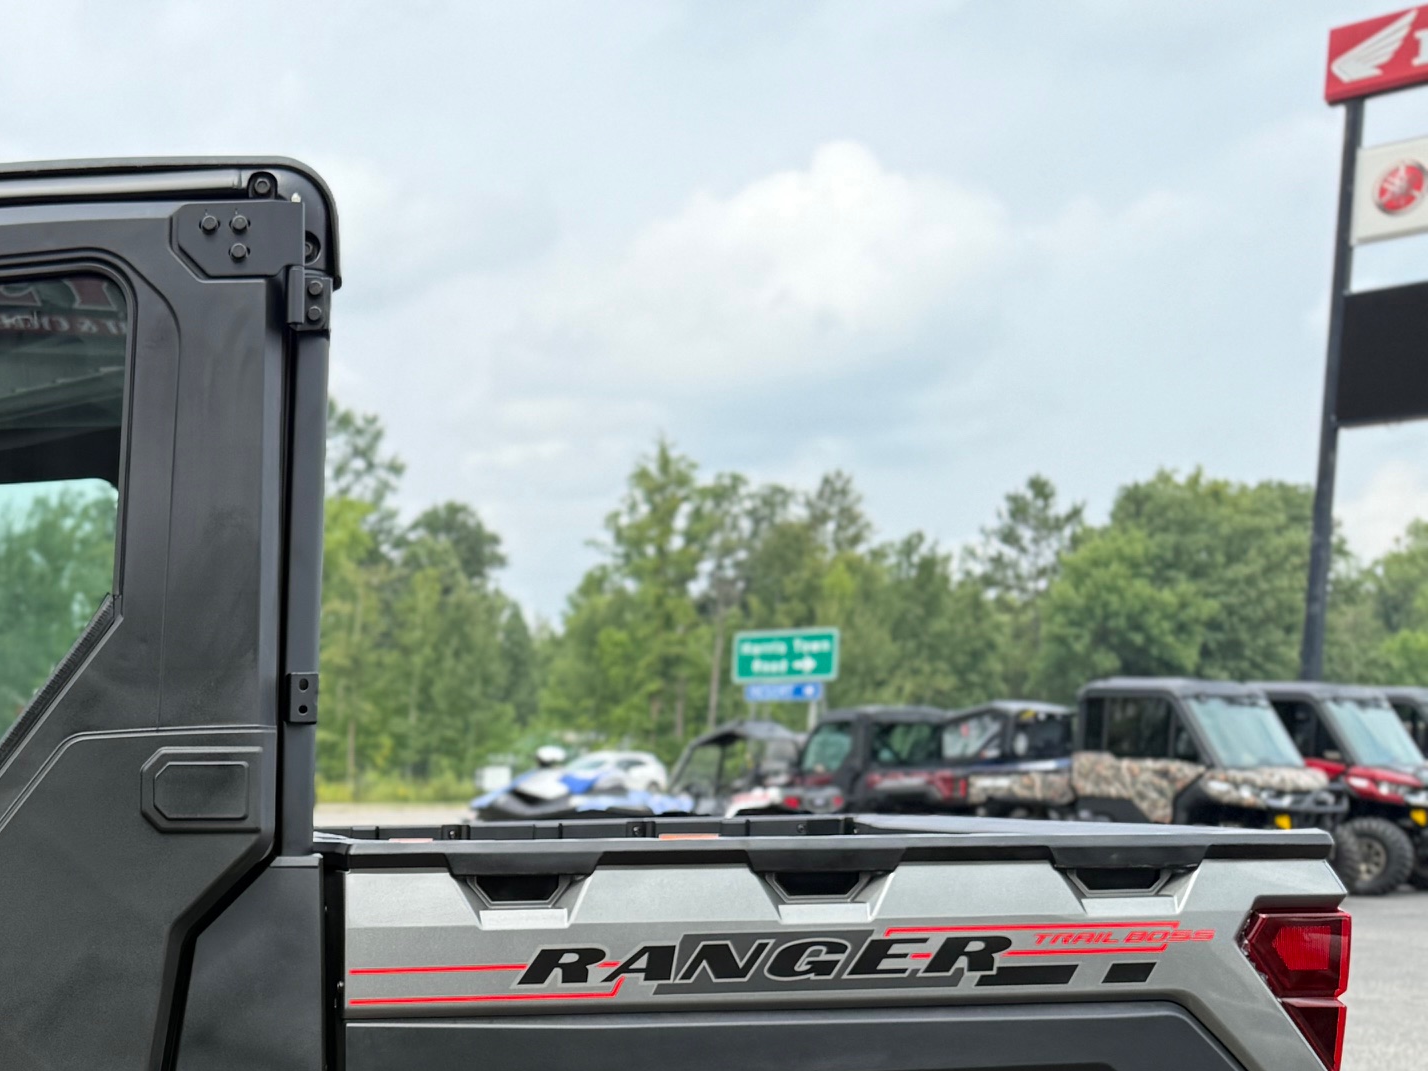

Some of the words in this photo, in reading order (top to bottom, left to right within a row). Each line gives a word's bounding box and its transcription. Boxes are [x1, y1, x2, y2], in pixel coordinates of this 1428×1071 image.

[1034, 931, 1119, 946] TRAIL
[1123, 929, 1217, 944] BOSS
[516, 935, 1013, 985] RANGER
